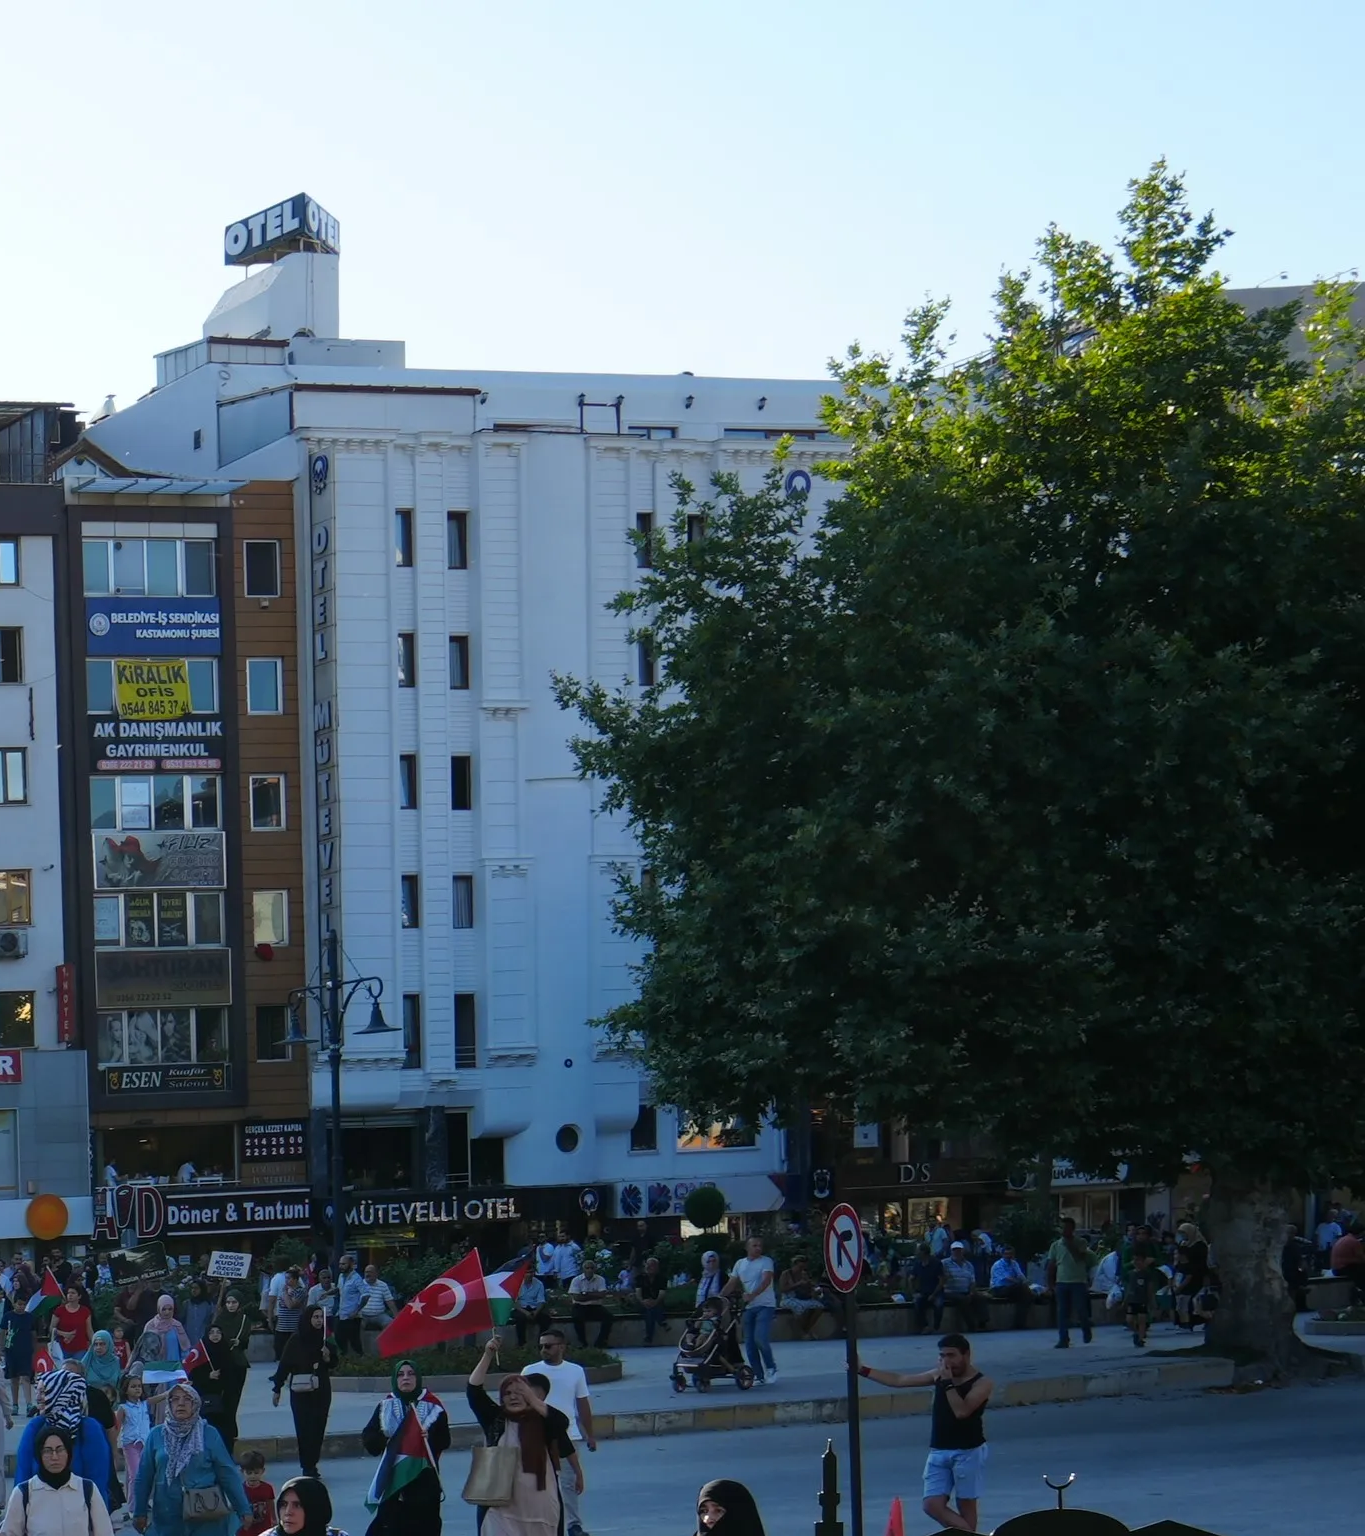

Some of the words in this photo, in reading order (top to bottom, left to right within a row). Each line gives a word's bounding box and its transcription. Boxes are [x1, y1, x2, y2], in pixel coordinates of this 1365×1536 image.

[225, 200, 301, 256] OTEL
[306, 200, 340, 250] OTEL
[313, 526, 329, 661] OTEL
[111, 611, 167, 625] BELEDİYE-İŞ
[169, 611, 219, 624] SENDİKASI
[136, 629, 189, 638] KASTAMONU
[191, 628, 220, 639] ŞUBESİ
[118, 664, 186, 684] KİRALIK
[136, 686, 175, 698] OFİS
[122, 701, 145, 715] 0544
[149, 701, 165, 715] 845
[168, 700, 178, 714] 37
[93, 723, 116, 738] AK
[119, 721, 222, 740] DANIŞMANLIK
[106, 743, 209, 757] GAYRİMENKUL
[121, 1071, 162, 1088] ESEN
[169, 1067, 207, 1076] Kuaför
[900, 1163, 931, 1184] D'S
[169, 1205, 219, 1225] Döner
[226, 1202, 237, 1222] &
[243, 1199, 309, 1222] Tantuni
[464, 1198, 521, 1220] OTEL
